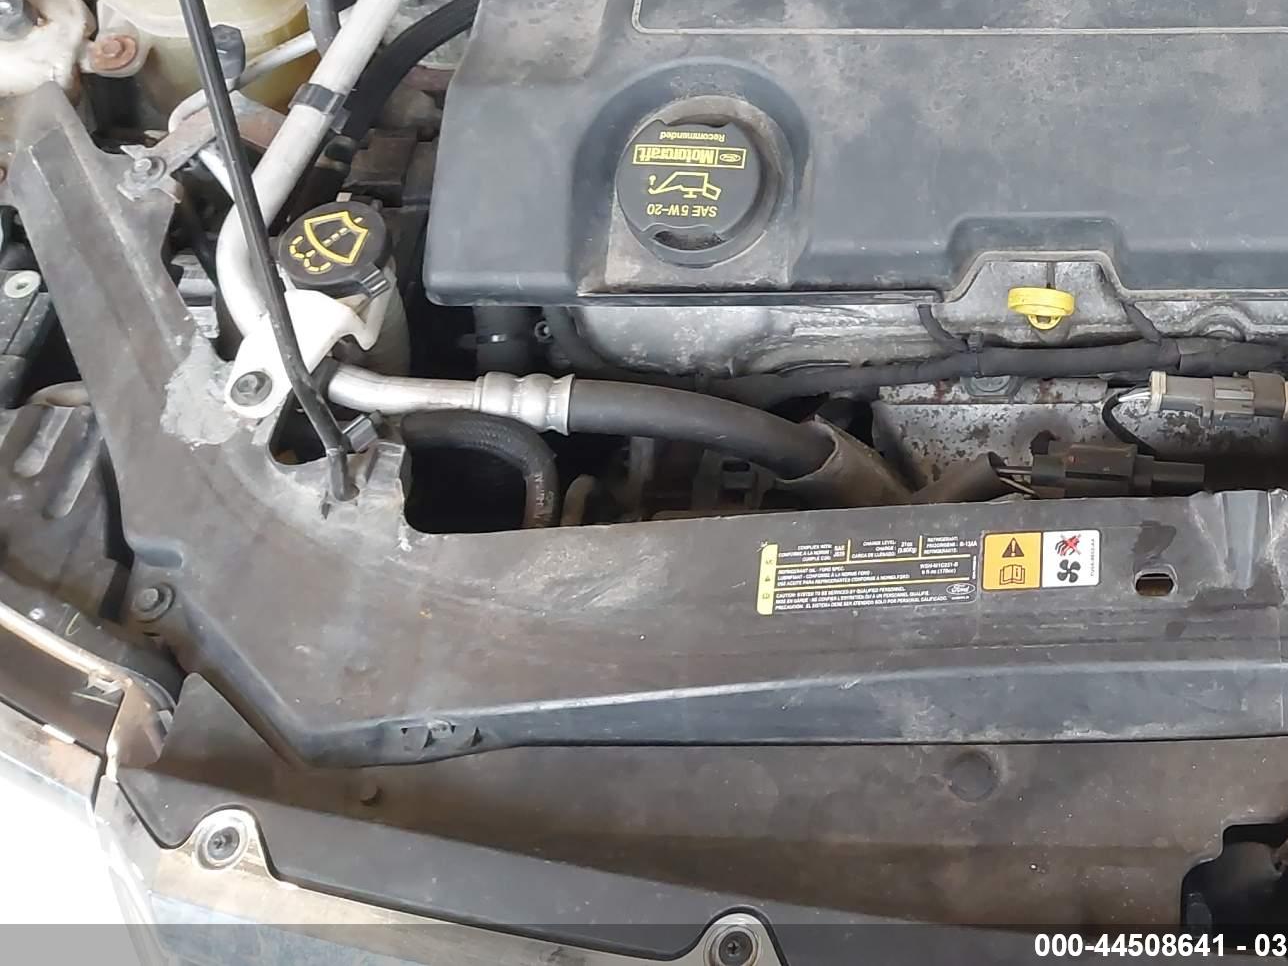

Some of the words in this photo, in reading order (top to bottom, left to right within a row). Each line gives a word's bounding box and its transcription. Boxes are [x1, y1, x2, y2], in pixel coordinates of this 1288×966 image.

[659, 131, 725, 143] Recommended
[638, 147, 715, 164] Motorcraft
[646, 203, 689, 217] 5W-20
[691, 205, 718, 218] SAE
